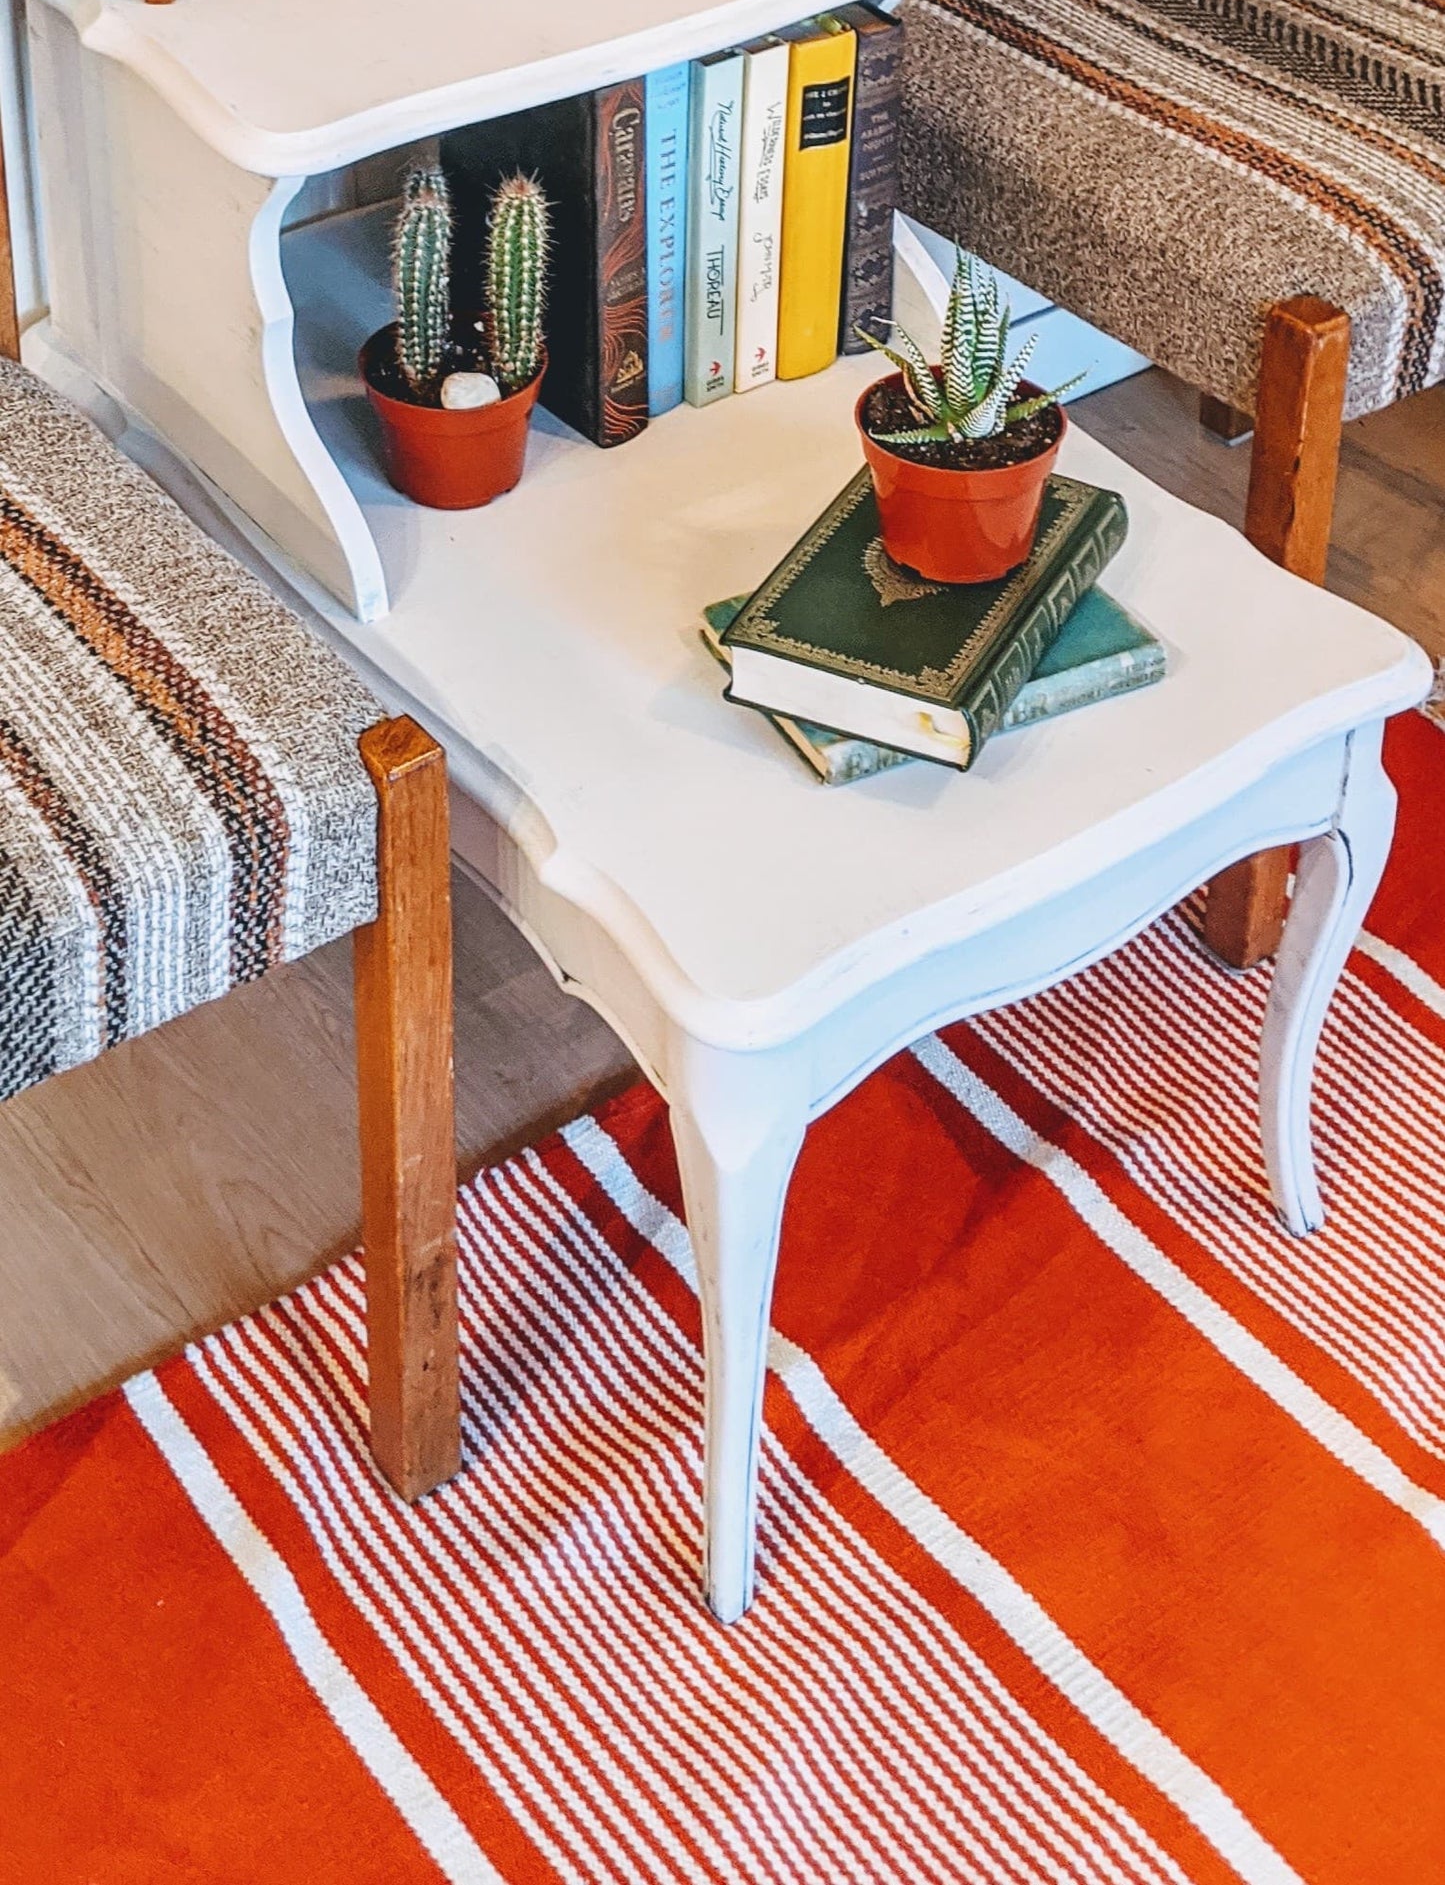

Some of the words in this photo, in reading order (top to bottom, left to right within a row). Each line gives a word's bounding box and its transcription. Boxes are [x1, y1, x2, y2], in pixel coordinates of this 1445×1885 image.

[612, 106, 641, 223] Caravans
[660, 127, 678, 190] THE
[706, 247, 724, 320] THOREAU
